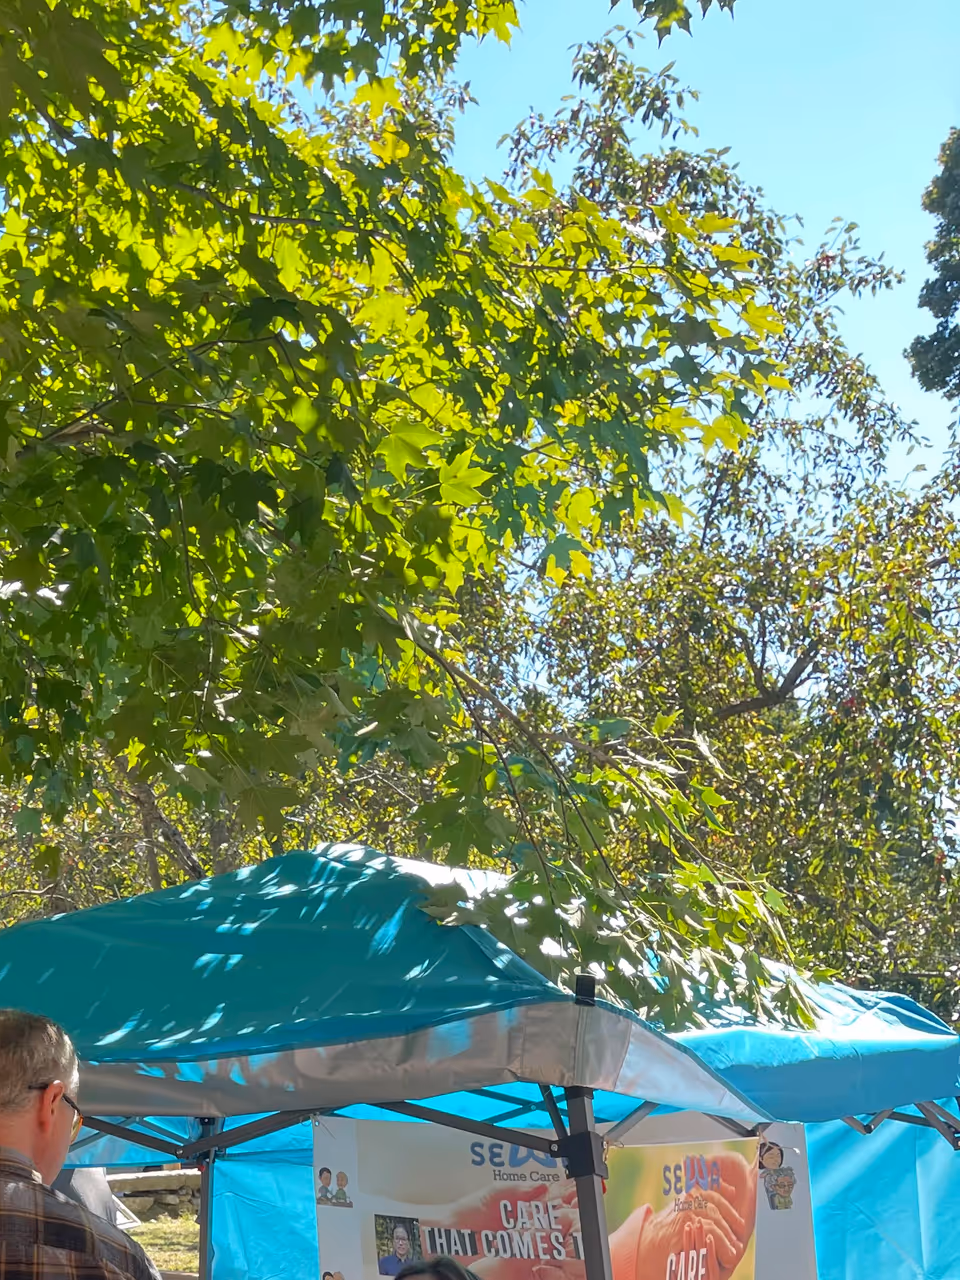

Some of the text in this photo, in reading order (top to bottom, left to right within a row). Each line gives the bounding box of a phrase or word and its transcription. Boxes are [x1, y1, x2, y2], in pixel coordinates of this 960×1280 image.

[470, 1141, 569, 1168] SEW
[493, 1169, 560, 1183] Home Care
[662, 1154, 722, 1196] SEWA
[500, 1200, 563, 1230] CARE
[422, 1226, 473, 1256] THAT
[481, 1229, 566, 1261] COMES
